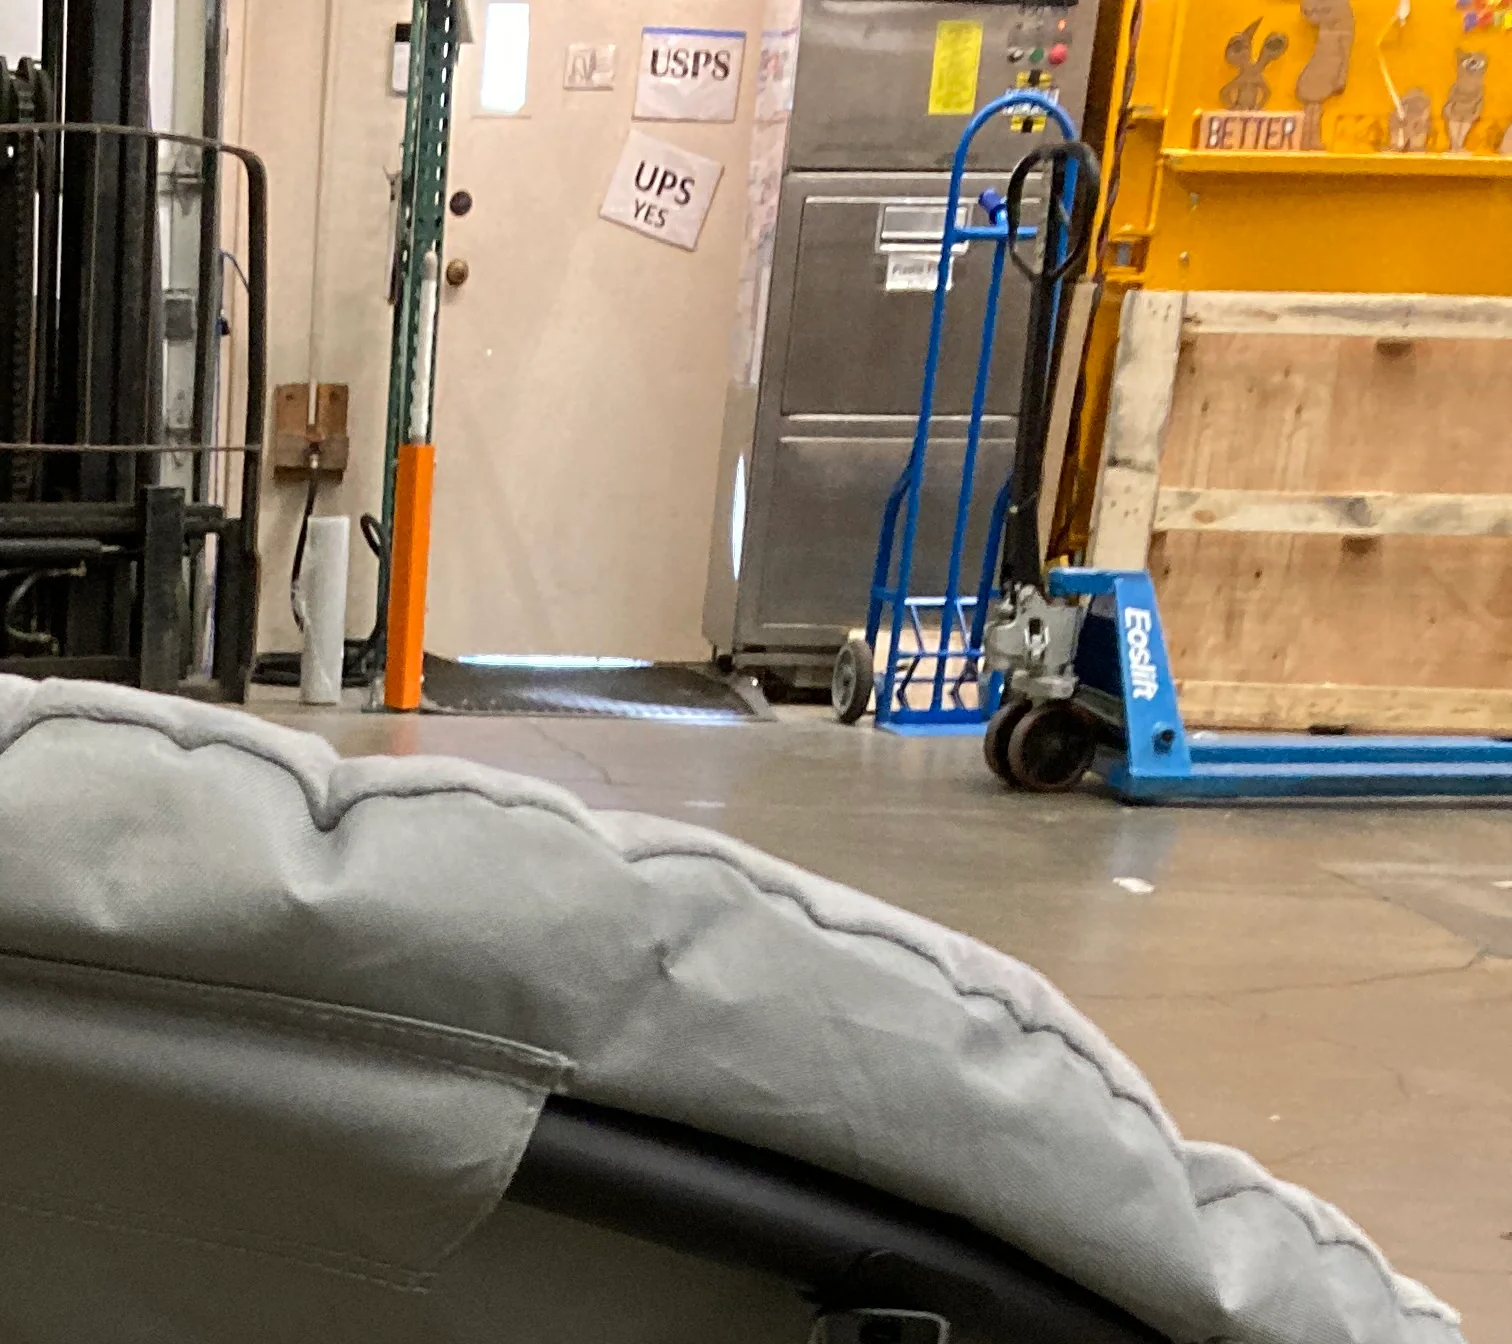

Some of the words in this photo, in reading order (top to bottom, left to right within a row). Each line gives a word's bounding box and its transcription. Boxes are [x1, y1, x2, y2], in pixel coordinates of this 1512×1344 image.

[650, 48, 731, 81] USPS
[1206, 115, 1297, 150] BETTER
[634, 160, 695, 205] UPS
[633, 198, 669, 228] YES
